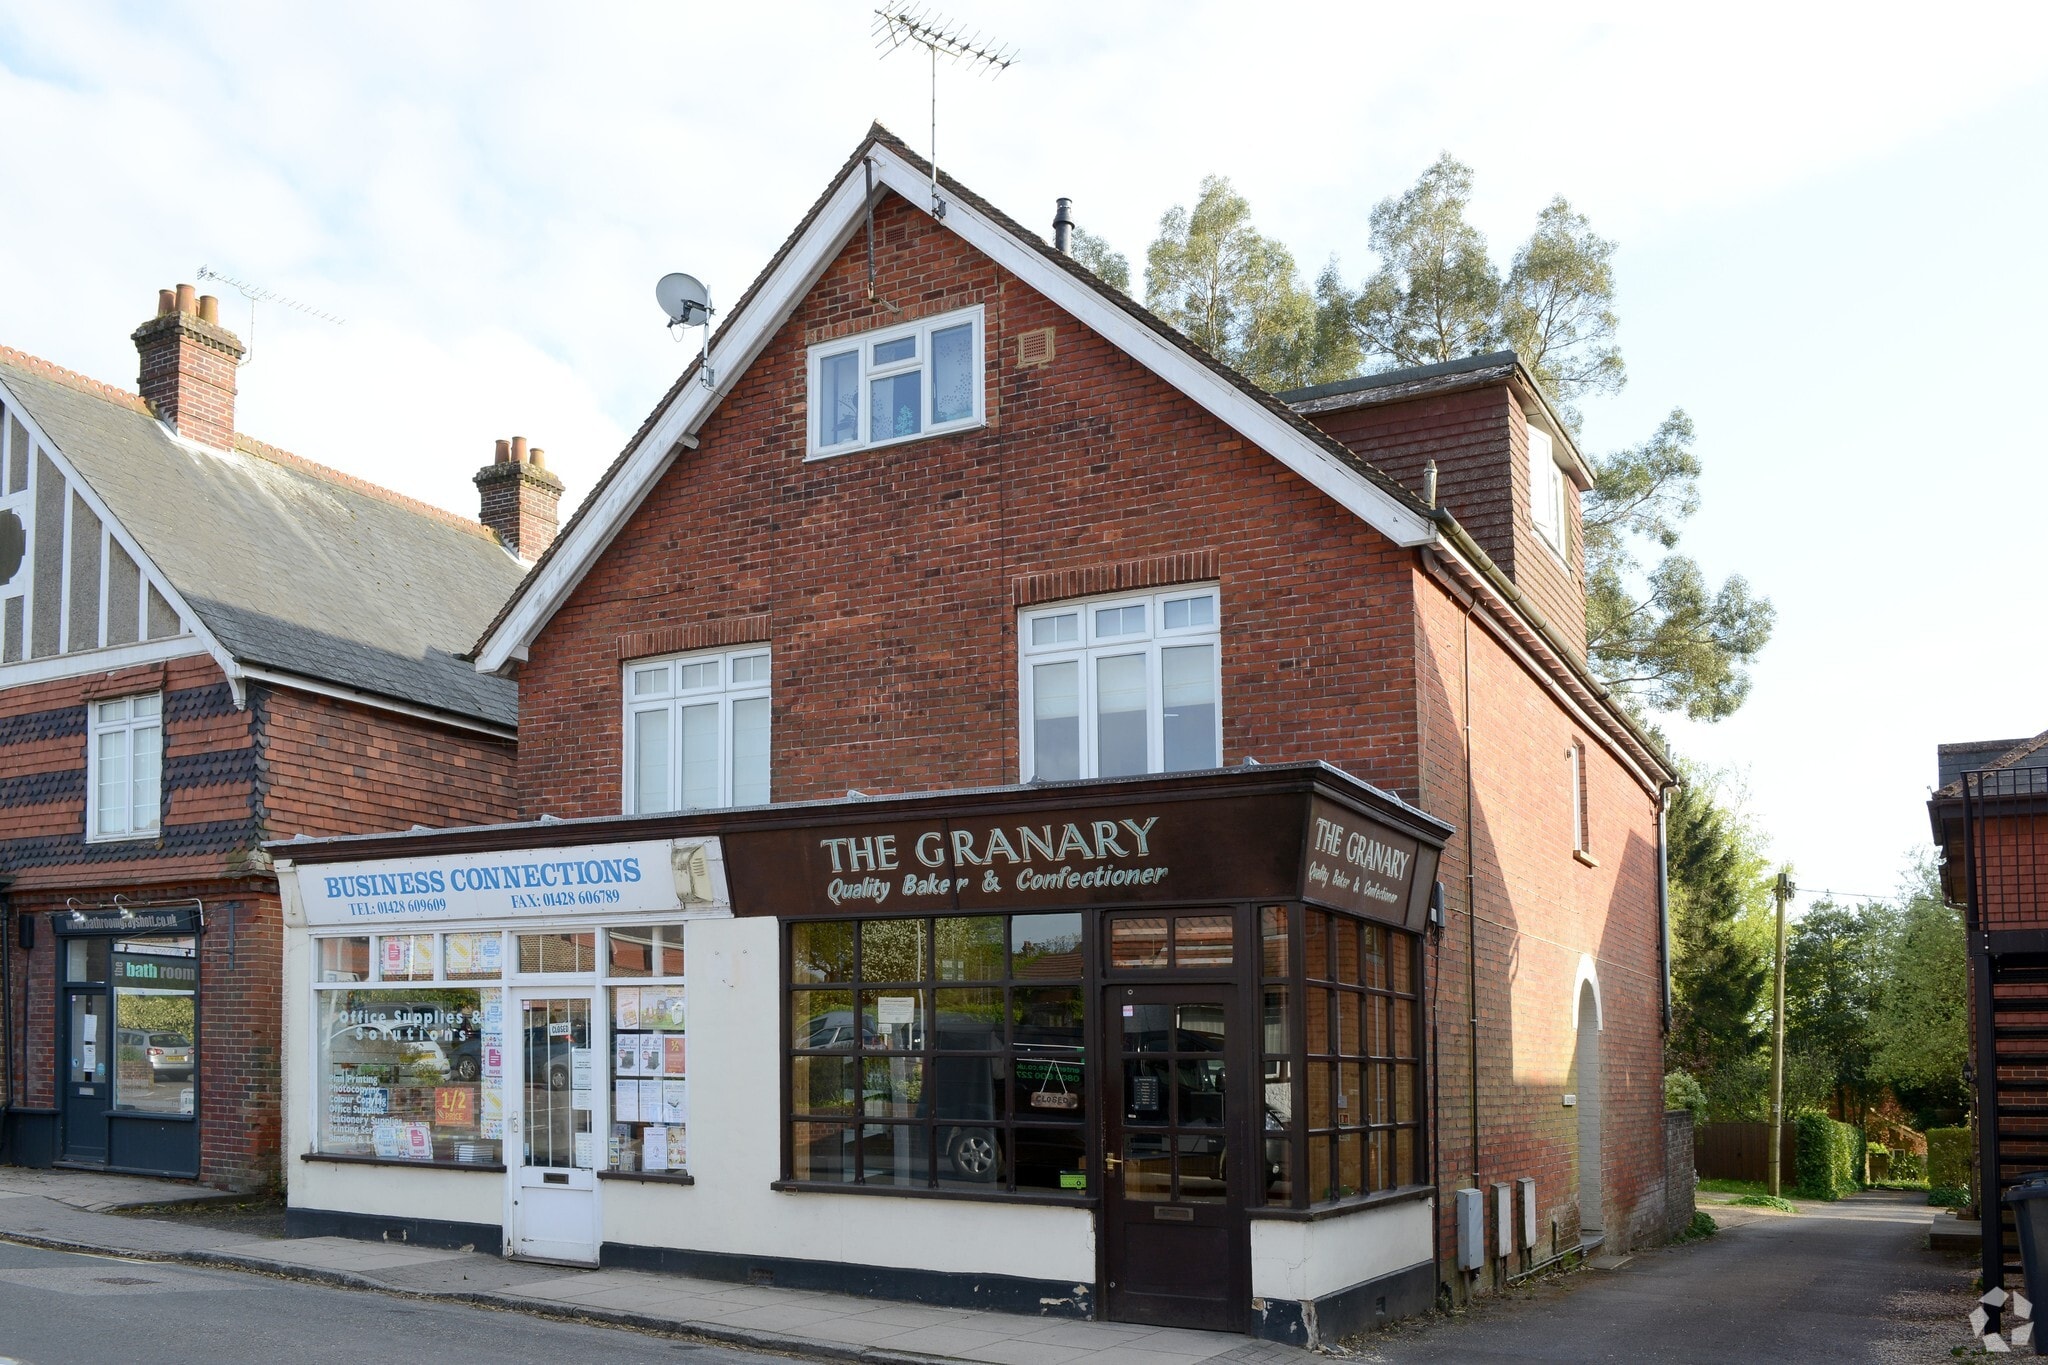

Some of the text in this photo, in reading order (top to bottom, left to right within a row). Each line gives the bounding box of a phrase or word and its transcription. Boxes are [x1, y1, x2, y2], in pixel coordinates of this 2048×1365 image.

[820, 816, 1159, 873] THE GRANARY
[1315, 818, 1410, 880] THE GRANARY
[324, 857, 641, 898] BUSINESS CONNECTIONS
[827, 865, 1169, 905] Quality Baker & Confectioner
[1308, 861, 1398, 904] Quality Baker & Confectioner
[511, 889, 620, 908] FAX: 01428 606789
[348, 898, 446, 916] TEL: 01428 609609
[114, 961, 195, 980] the bath room
[339, 1009, 481, 1027] Office Supplies &
[356, 1027, 466, 1041] Solutions
[552, 1025, 569, 1033] CLOSED
[346, 1075, 378, 1086] Printing
[328, 1085, 380, 1096] Photocopying
[328, 1095, 387, 1107] Colour Copying
[442, 1089, 466, 1112] 1/2
[1036, 1096, 1068, 1104] CLOSED
[328, 1105, 384, 1116] Office Supplies
[445, 1112, 463, 1121] PRICE
[328, 1115, 369, 1126] Stationery
[328, 1125, 359, 1135] Printing
